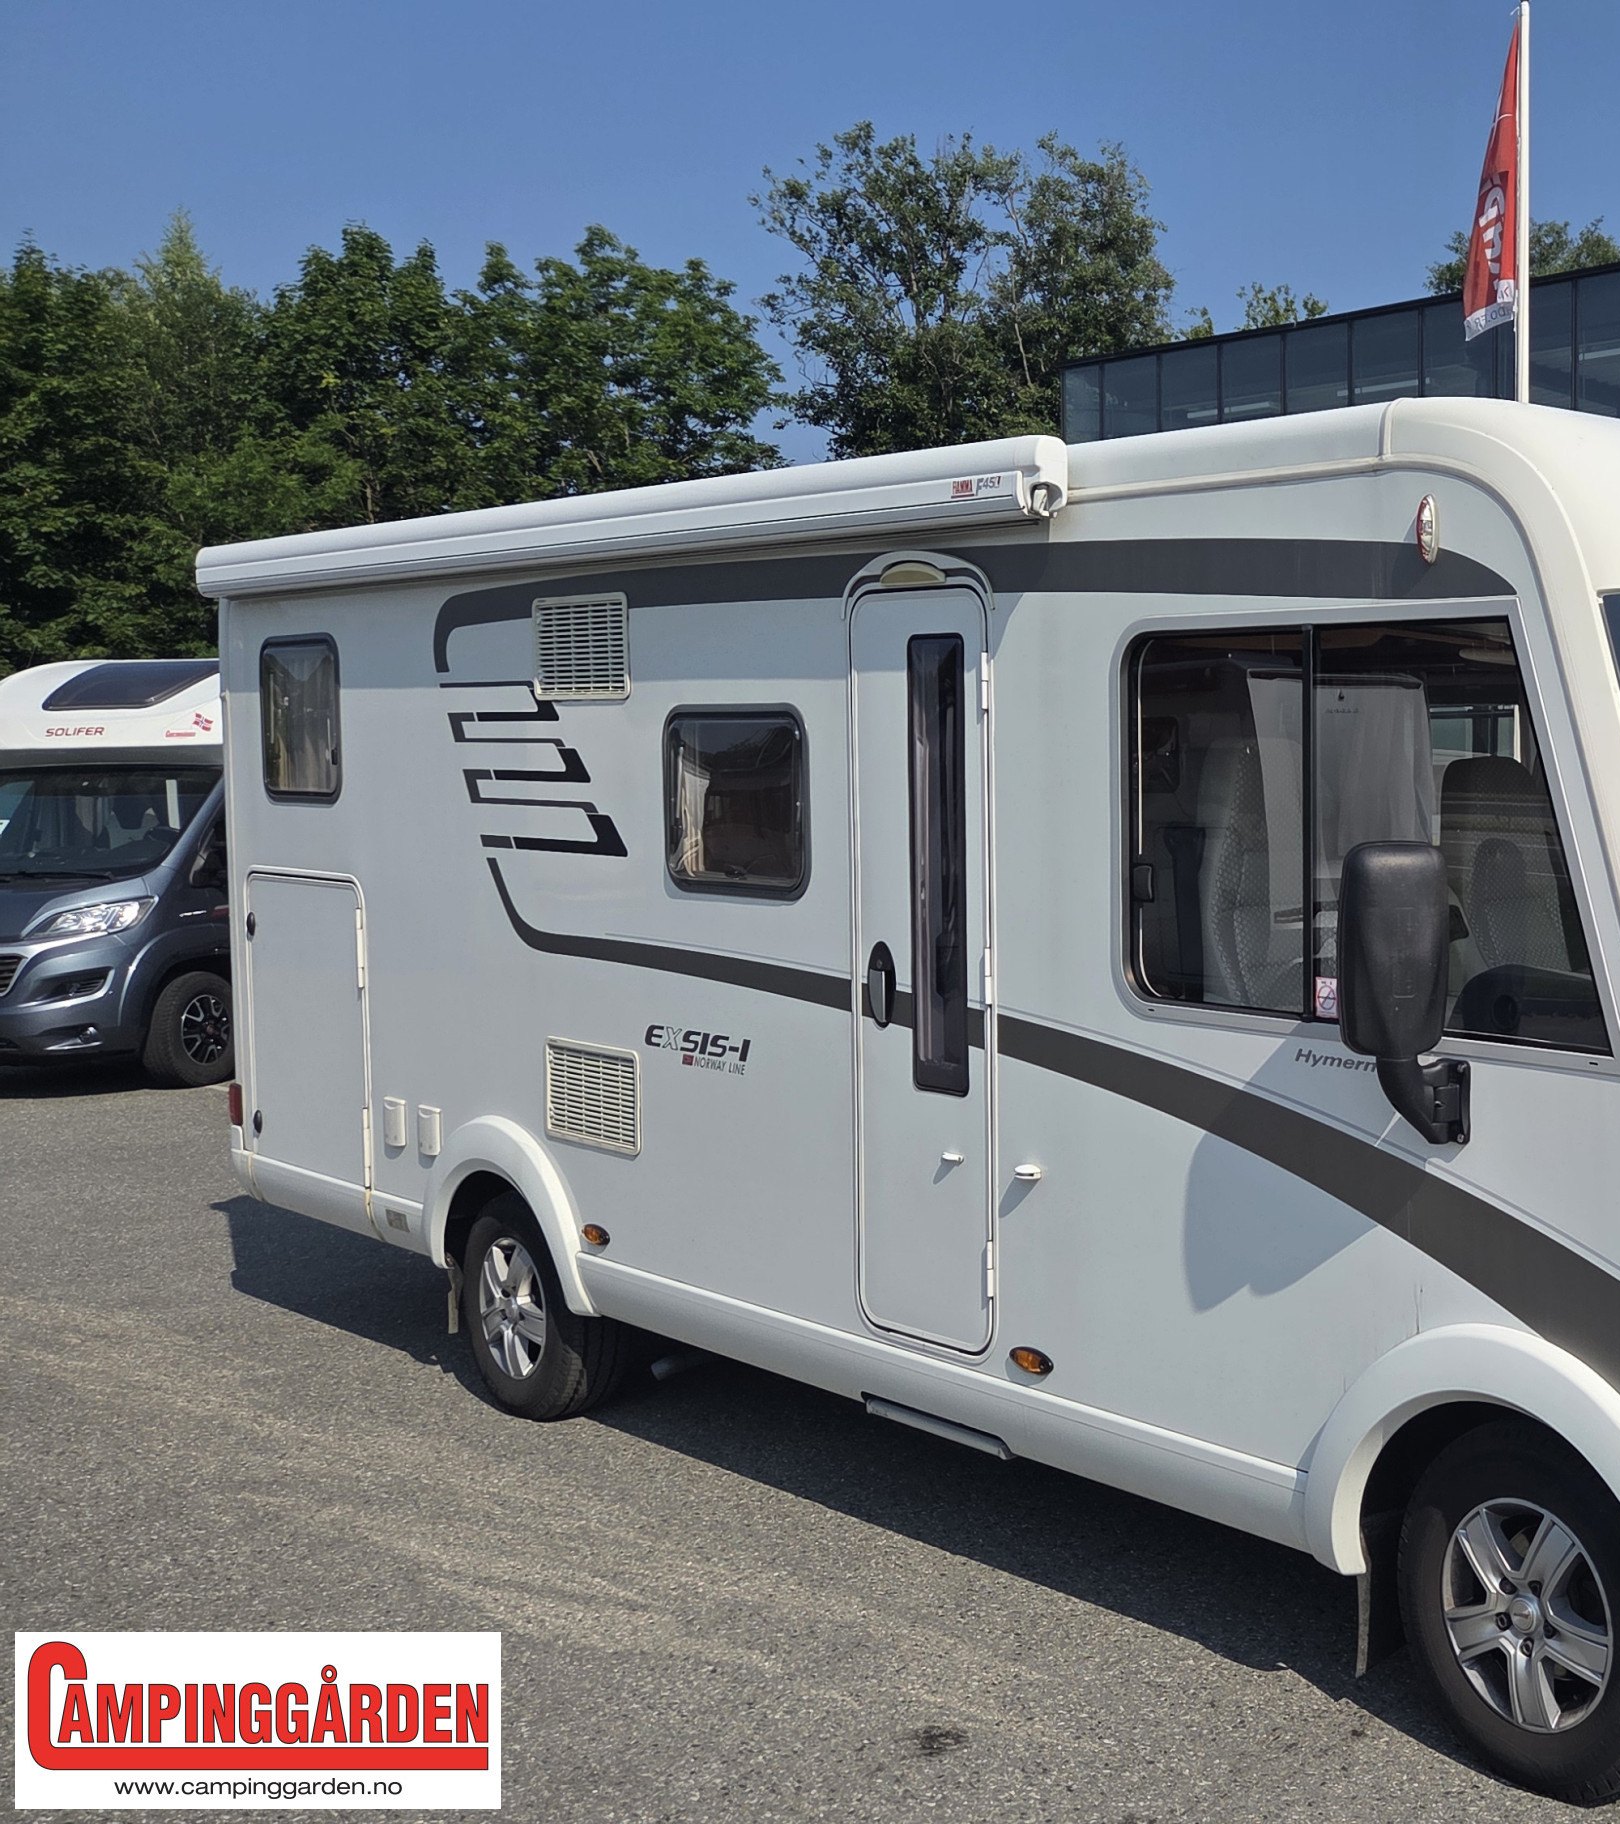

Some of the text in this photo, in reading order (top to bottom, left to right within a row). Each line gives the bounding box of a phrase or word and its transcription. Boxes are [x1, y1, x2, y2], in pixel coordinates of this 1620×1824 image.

[45, 726, 105, 737] SOLIFER
[693, 1056, 746, 1075] NORWAY LINE
